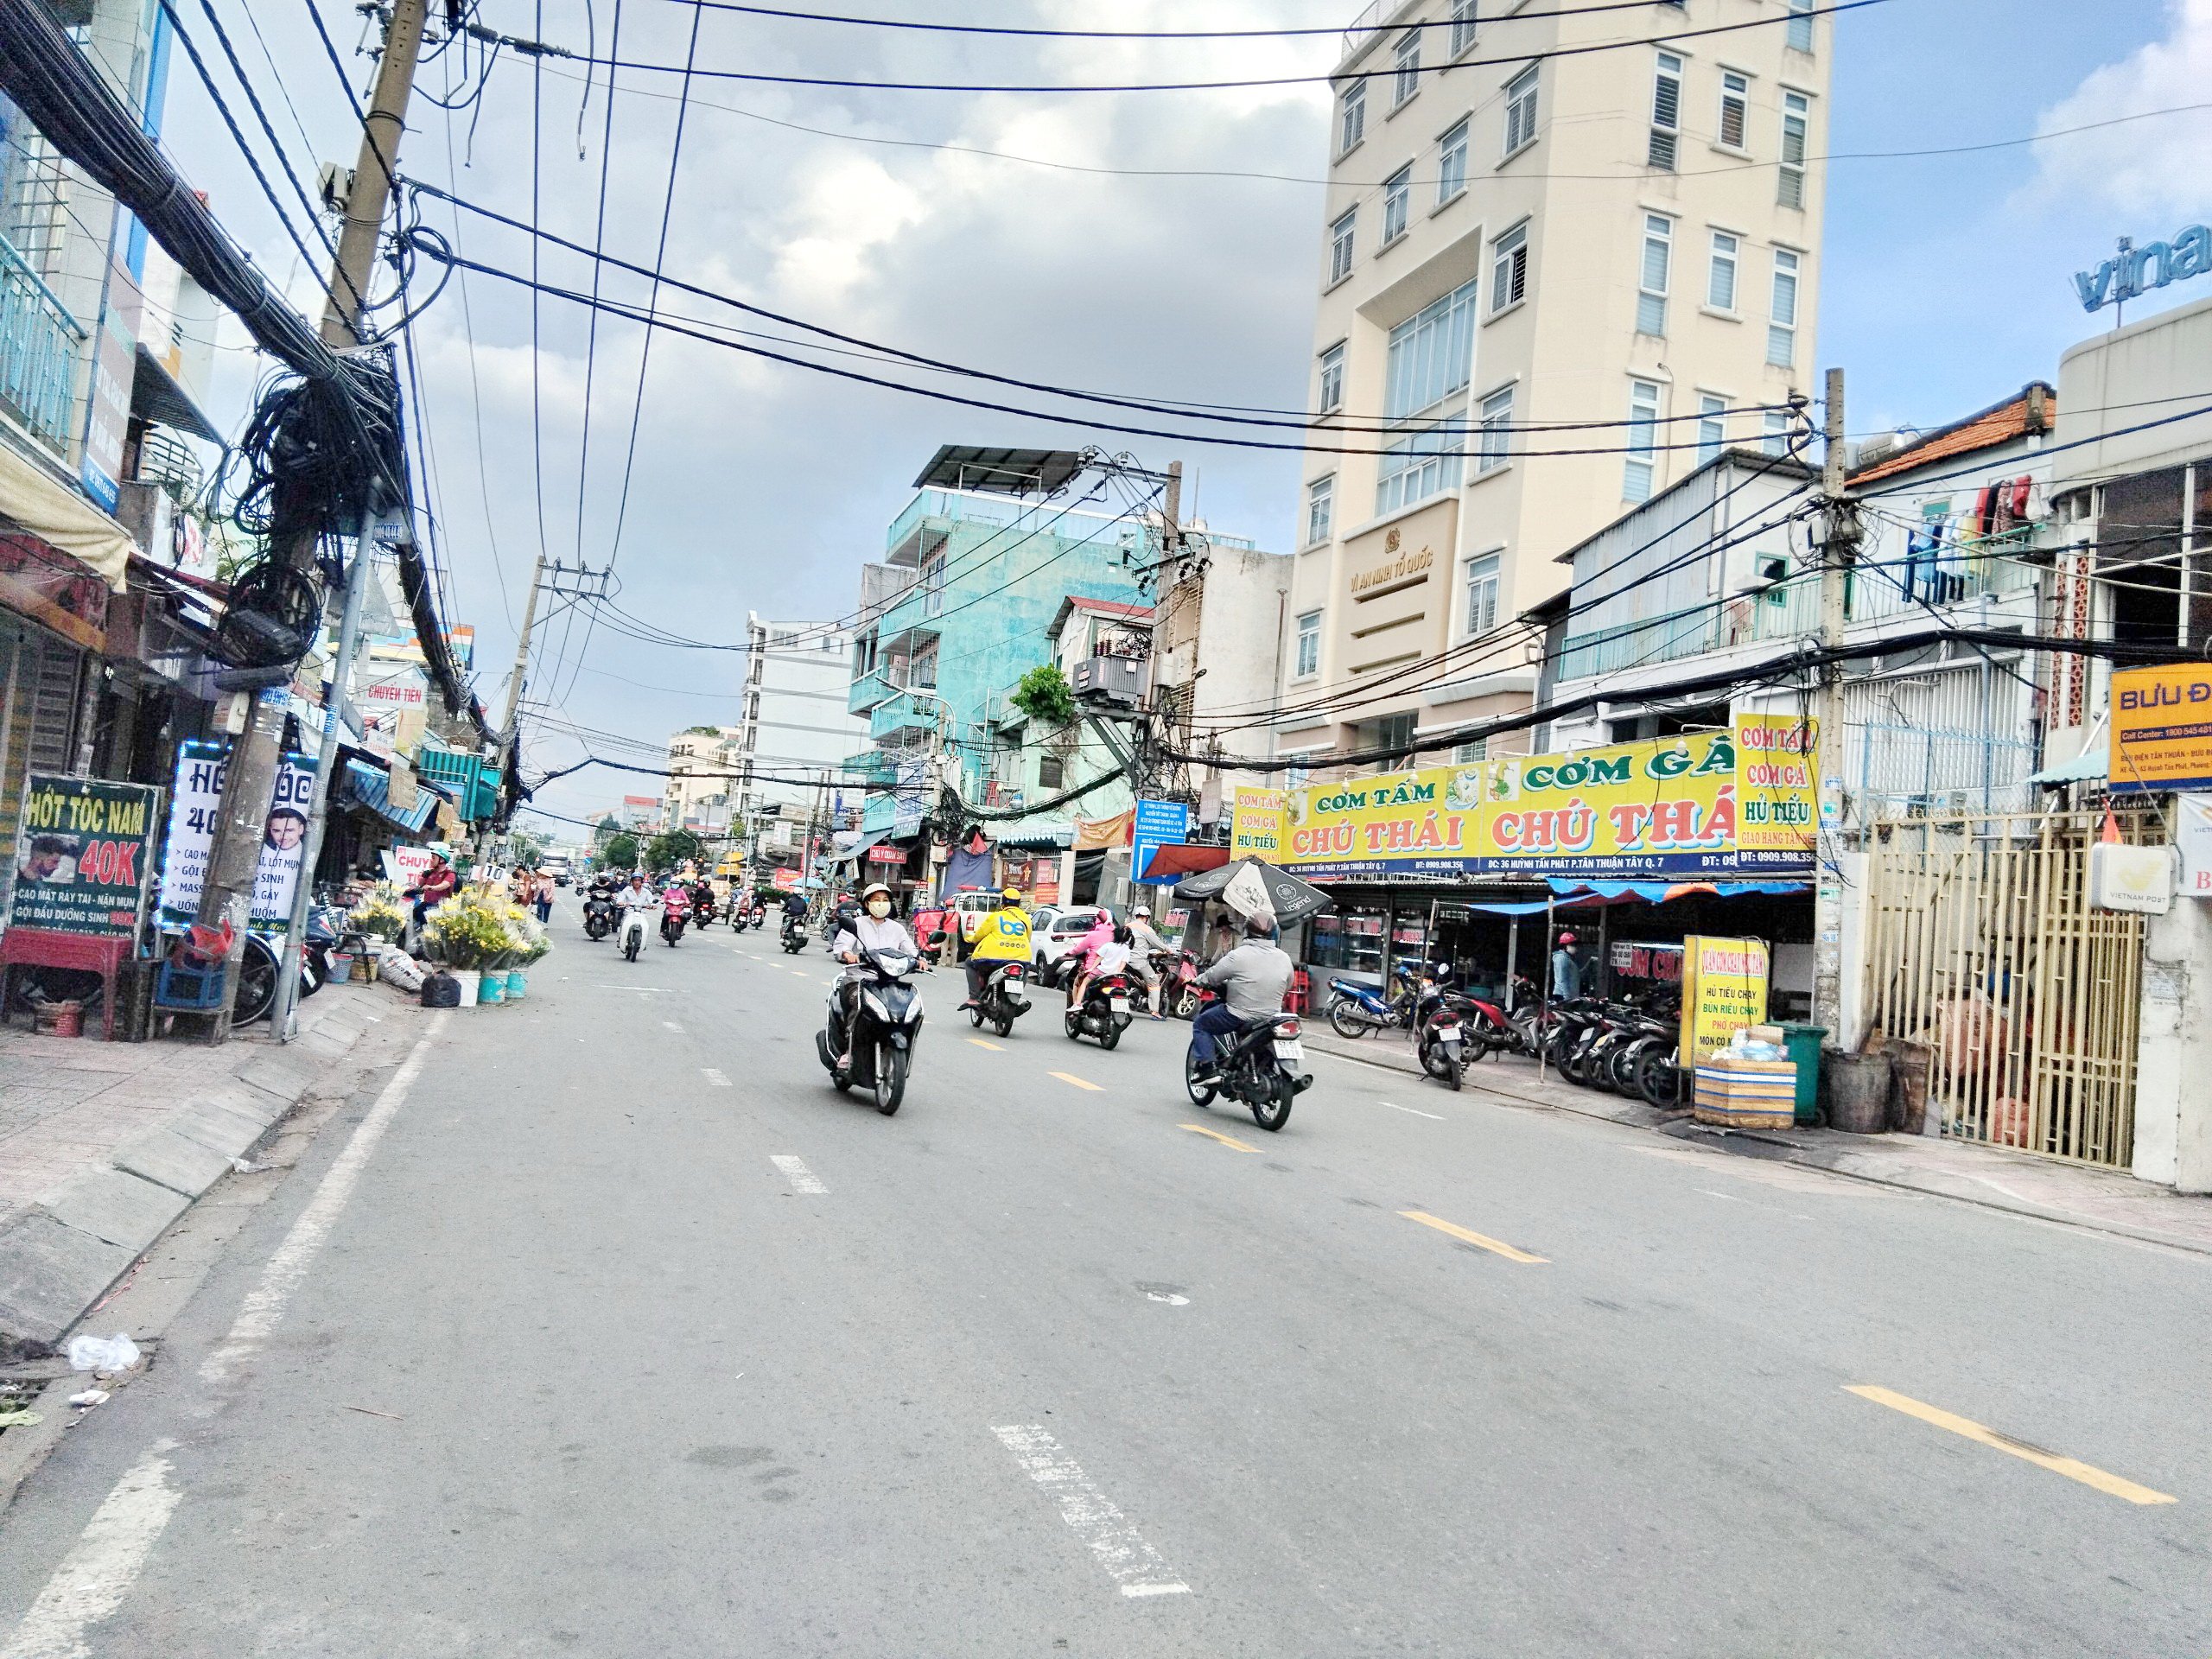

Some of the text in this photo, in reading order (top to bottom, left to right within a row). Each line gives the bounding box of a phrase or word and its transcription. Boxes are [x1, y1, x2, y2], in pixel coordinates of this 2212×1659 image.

[1351, 544, 1433, 593] VÌ AN NINH TỔ QUỐC
[2120, 683, 2181, 710] BƯU
[1741, 724, 1777, 750] CƠM
[2138, 730, 2164, 739] Center:
[1525, 755, 1632, 791] CƠM
[1747, 761, 1781, 787] CƠM
[1784, 760, 1808, 787] GÀ
[274, 762, 312, 804] ÓC
[1238, 792, 1282, 810] CƠM TẤM
[1316, 779, 1435, 813] CƠM TẤM
[27, 784, 65, 828] HỚT
[107, 800, 145, 835] NAM
[1745, 793, 1810, 823] HỦ TIẾU
[1241, 815, 1277, 830] CƠM GÀ
[1491, 784, 1735, 853] CHÚ THÁ
[1237, 830, 1278, 849] HỦ TIẾU
[1293, 810, 1464, 856] CHÚ THÁI
[1742, 831, 1760, 843] GIAO
[1762, 830, 1783, 844] HÀNG
[79, 840, 140, 886] 40K
[398, 855, 432, 869] CHUY
[1501, 859, 1510, 868] 36
[1510, 858, 1532, 868] HUỲNH
[1535, 856, 1549, 868] TẤN
[1550, 857, 1570, 868] PHÁT
[1571, 857, 1594, 868] P.TÂN
[1596, 857, 1623, 870] THUẬN
[1624, 856, 1643, 868] TÂY
[1645, 857, 1655, 868] Q.
[1657, 857, 1664, 868] 7
[1702, 855, 1719, 867] ĐT:
[1740, 851, 1755, 861] ĐT:
[181, 865, 283, 884] GỘI SINH
[407, 870, 422, 885] TI
[486, 865, 504, 880] 10
[179, 882, 203, 893] MASS
[18, 888, 36, 902] CẠO
[38, 888, 57, 905] MẶT
[78, 893, 92, 904] TAI
[117, 895, 136, 908] MỤN
[2109, 892, 2143, 901] VIETNAM
[54, 906, 86, 922] DƯỠNG
[88, 912, 109, 923] SINH
[251, 906, 276, 919] HUỘM
[1000, 916, 1025, 936] be
[1707, 984, 1756, 1000] HỦ TIẾU CHAY
[1703, 1002, 1759, 1016] BÚN RIÊU CHAY
[1712, 1020, 1749, 1031] PHỞ CHAY
[1700, 1034, 1713, 1046] MÓN
